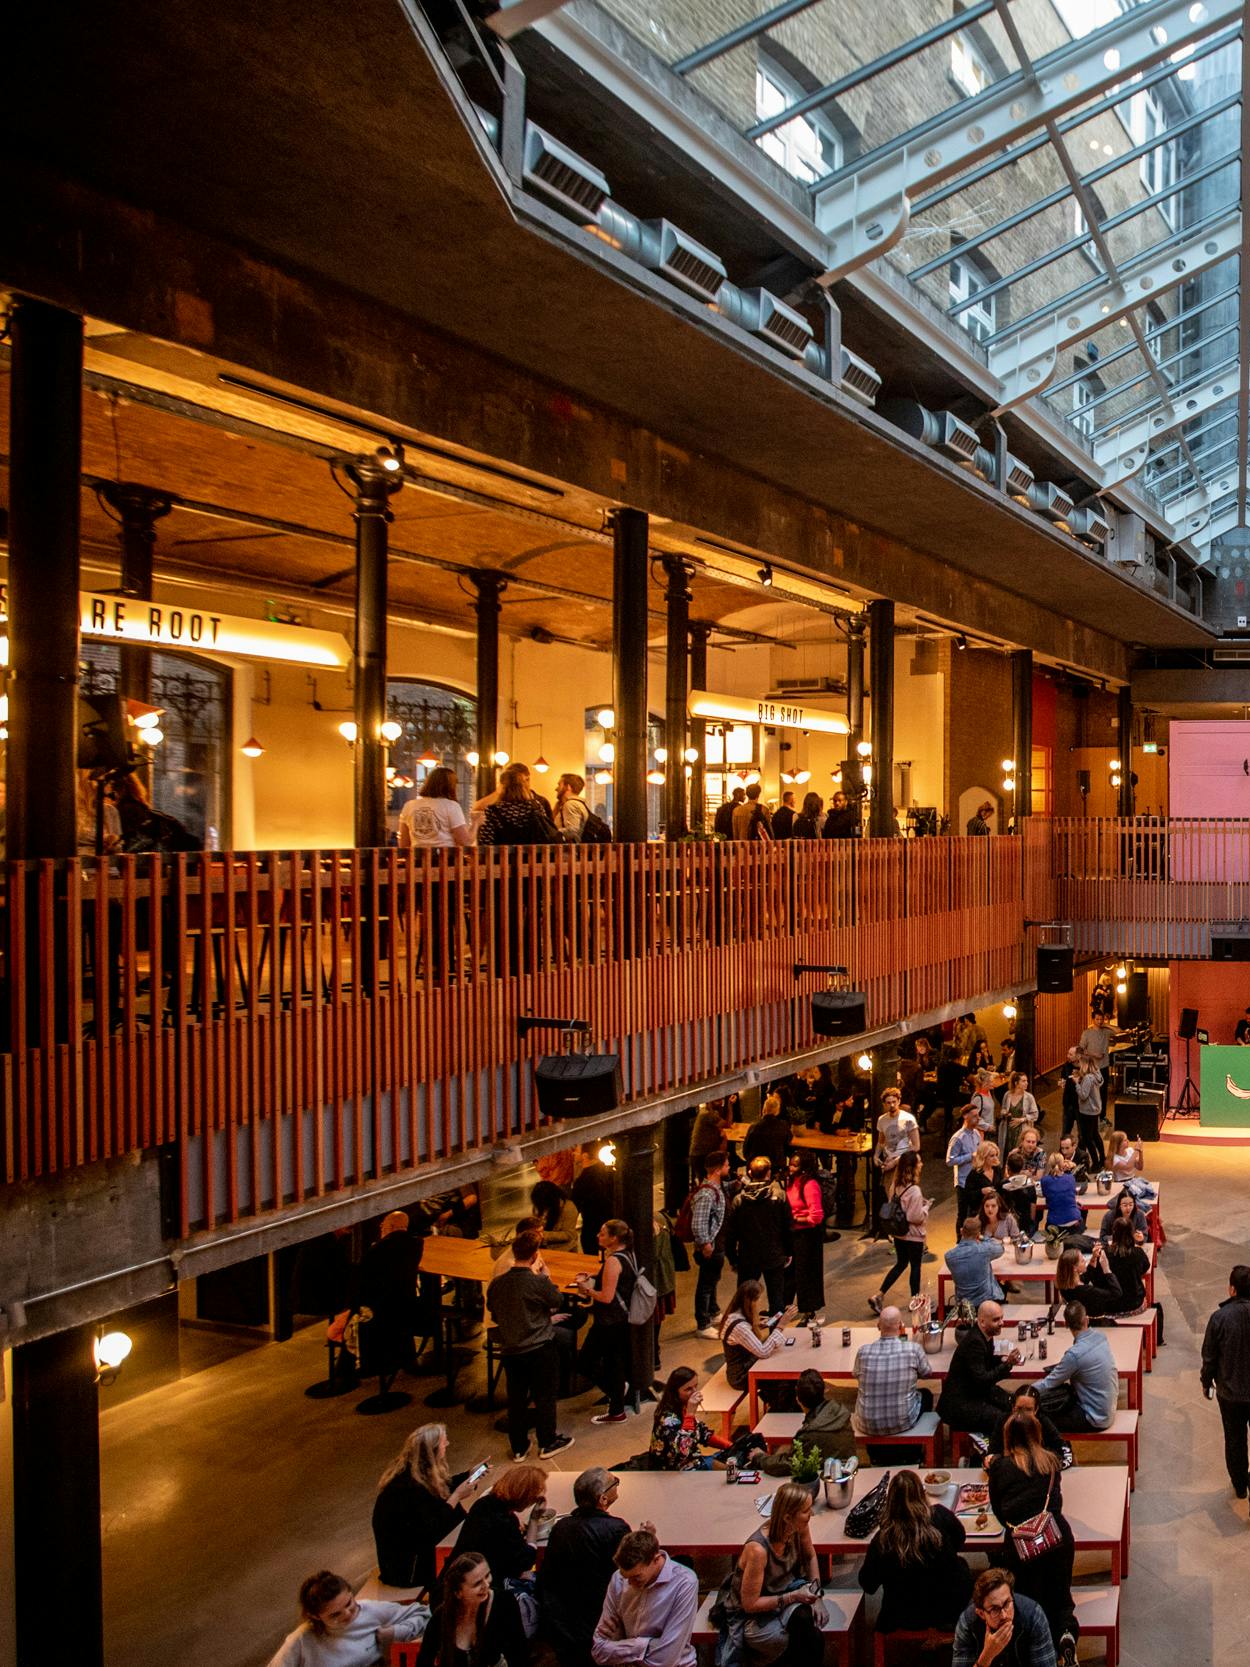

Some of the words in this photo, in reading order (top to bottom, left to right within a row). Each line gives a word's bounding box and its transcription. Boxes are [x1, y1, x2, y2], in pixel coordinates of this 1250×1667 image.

[149, 607, 222, 644] ROOT
[758, 703, 775, 721] BIG
[781, 706, 803, 723] SHOT
